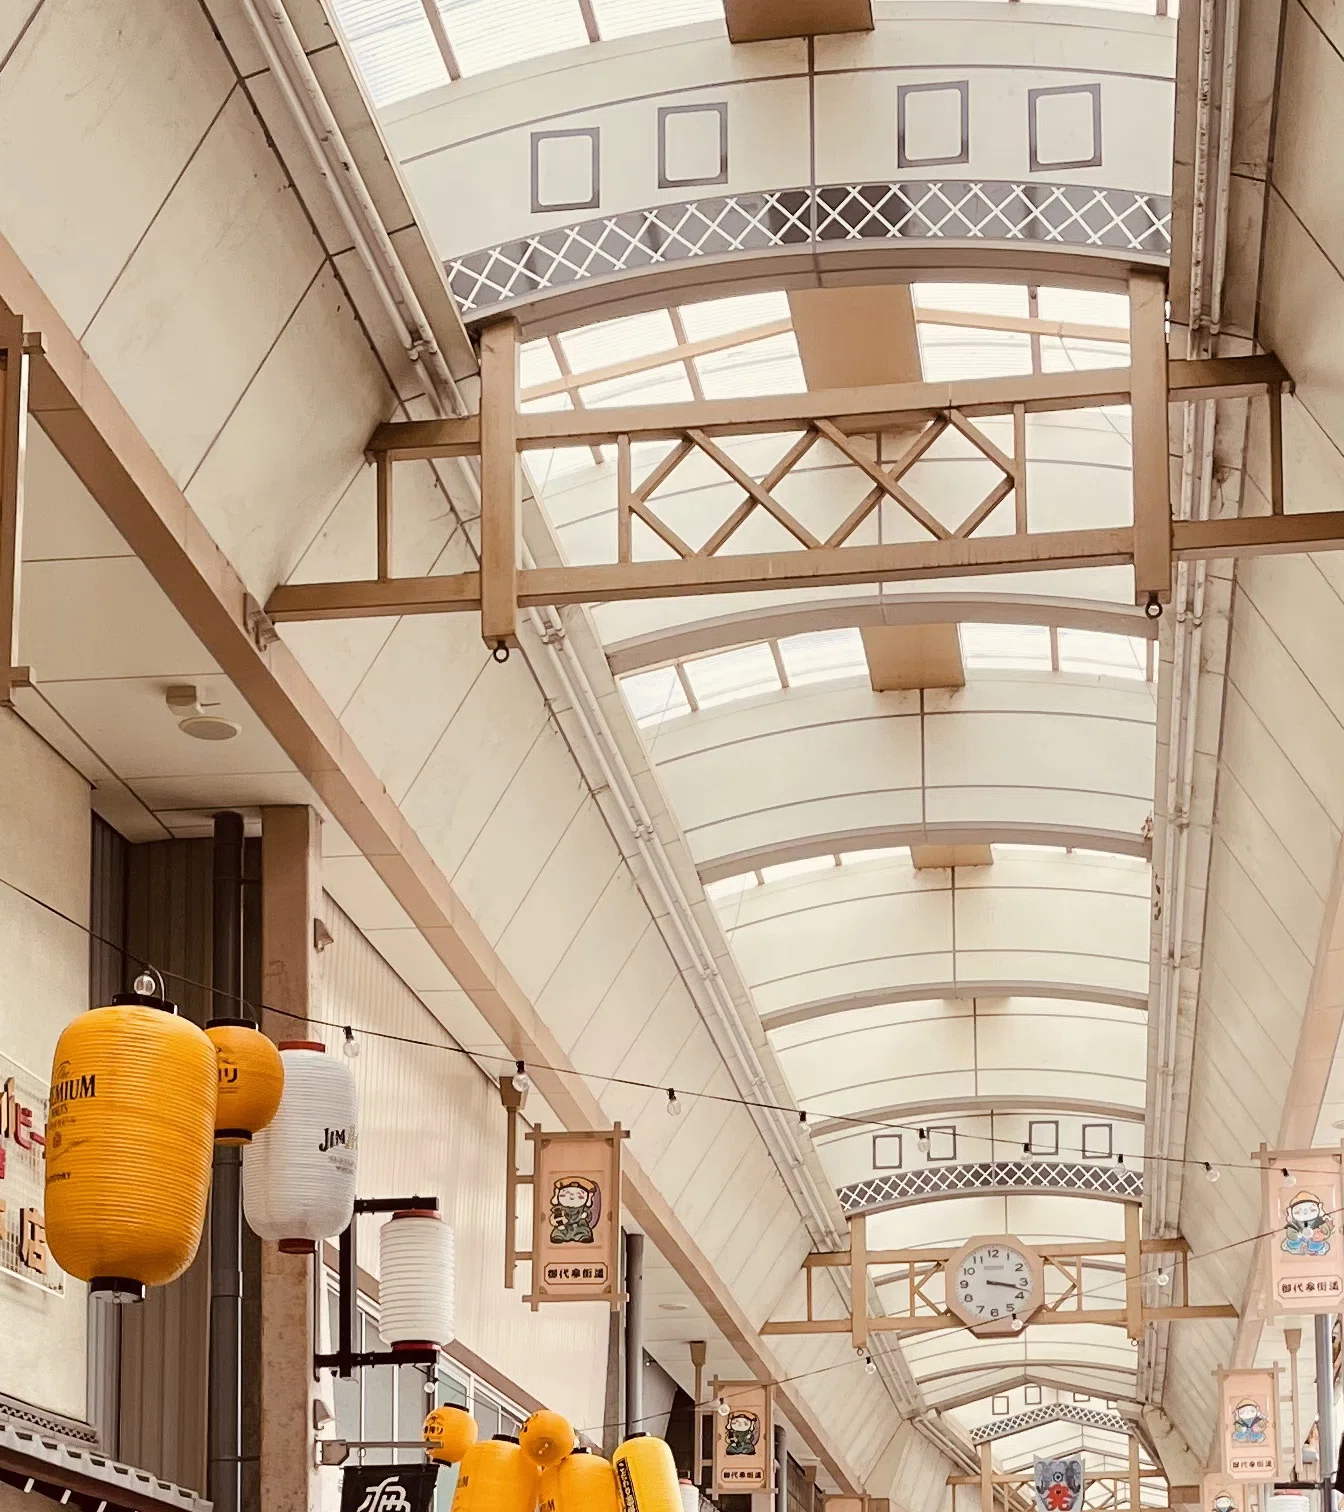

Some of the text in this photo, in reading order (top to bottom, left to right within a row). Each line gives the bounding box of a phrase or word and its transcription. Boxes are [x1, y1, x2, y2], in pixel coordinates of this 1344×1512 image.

[318, 1127, 346, 1152] JIM
[988, 1250, 999, 1258] 12
[1007, 1253, 1010, 1261] 1
[973, 1256, 983, 1264] 11
[963, 1267, 975, 1275] 10
[1015, 1264, 1023, 1272] 2
[960, 1280, 968, 1288] 9
[1020, 1278, 1028, 1286] 3
[964, 1294, 973, 1302] 8
[976, 1306, 984, 1314] 7
[1006, 1304, 1014, 1312] 5
[991, 1309, 998, 1317] 6
